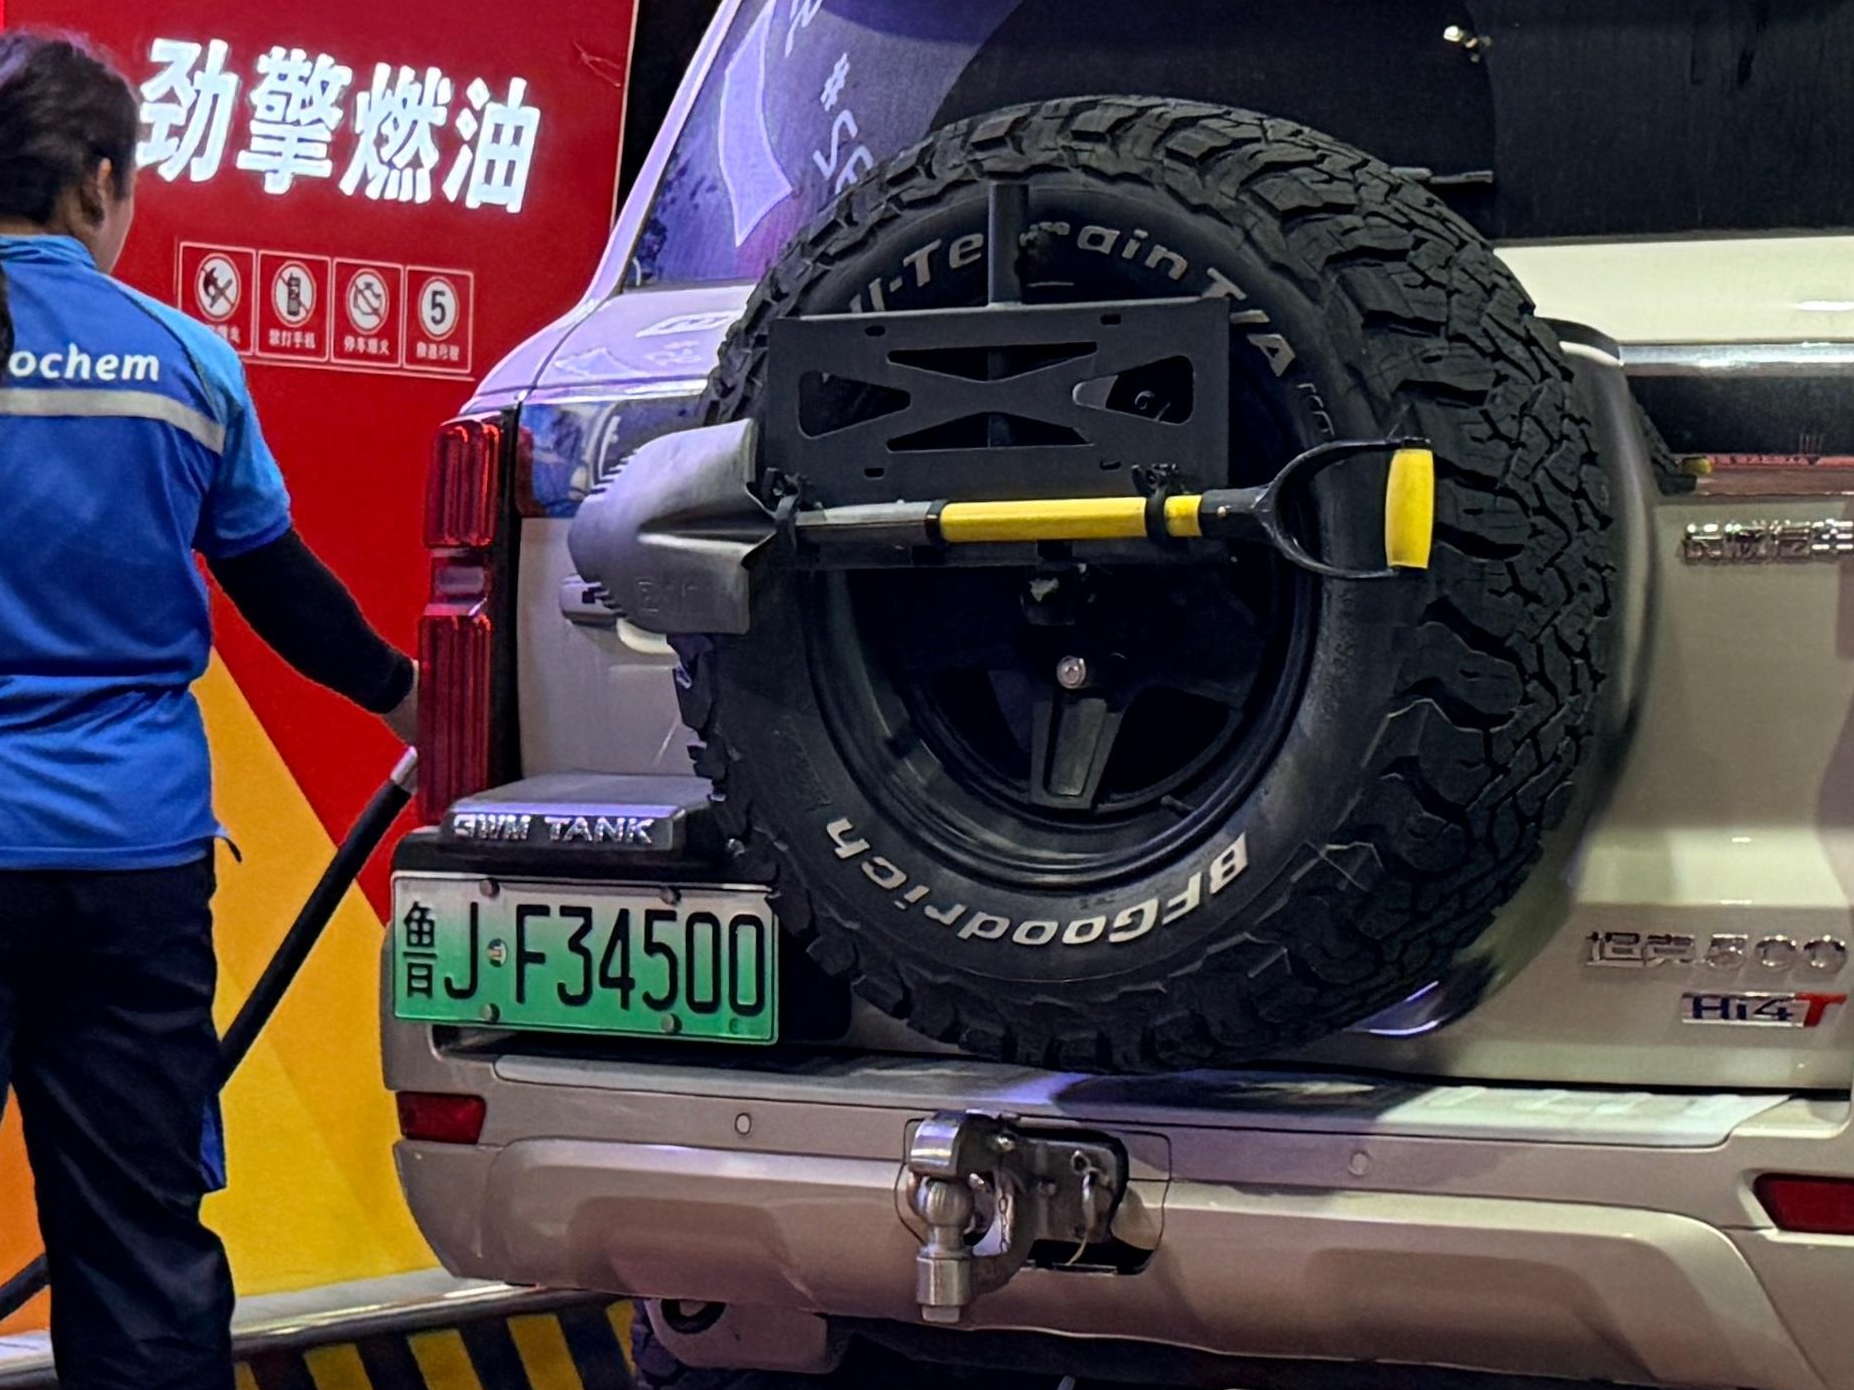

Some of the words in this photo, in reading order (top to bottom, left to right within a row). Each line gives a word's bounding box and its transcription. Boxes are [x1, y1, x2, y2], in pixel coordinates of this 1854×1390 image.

[135, 38, 542, 214] 劲擎燃油
[430, 290, 447, 326] 5
[7, 341, 160, 382] ochem
[543, 815, 655, 845] TANK
[825, 816, 1249, 946] BFGoodrich
